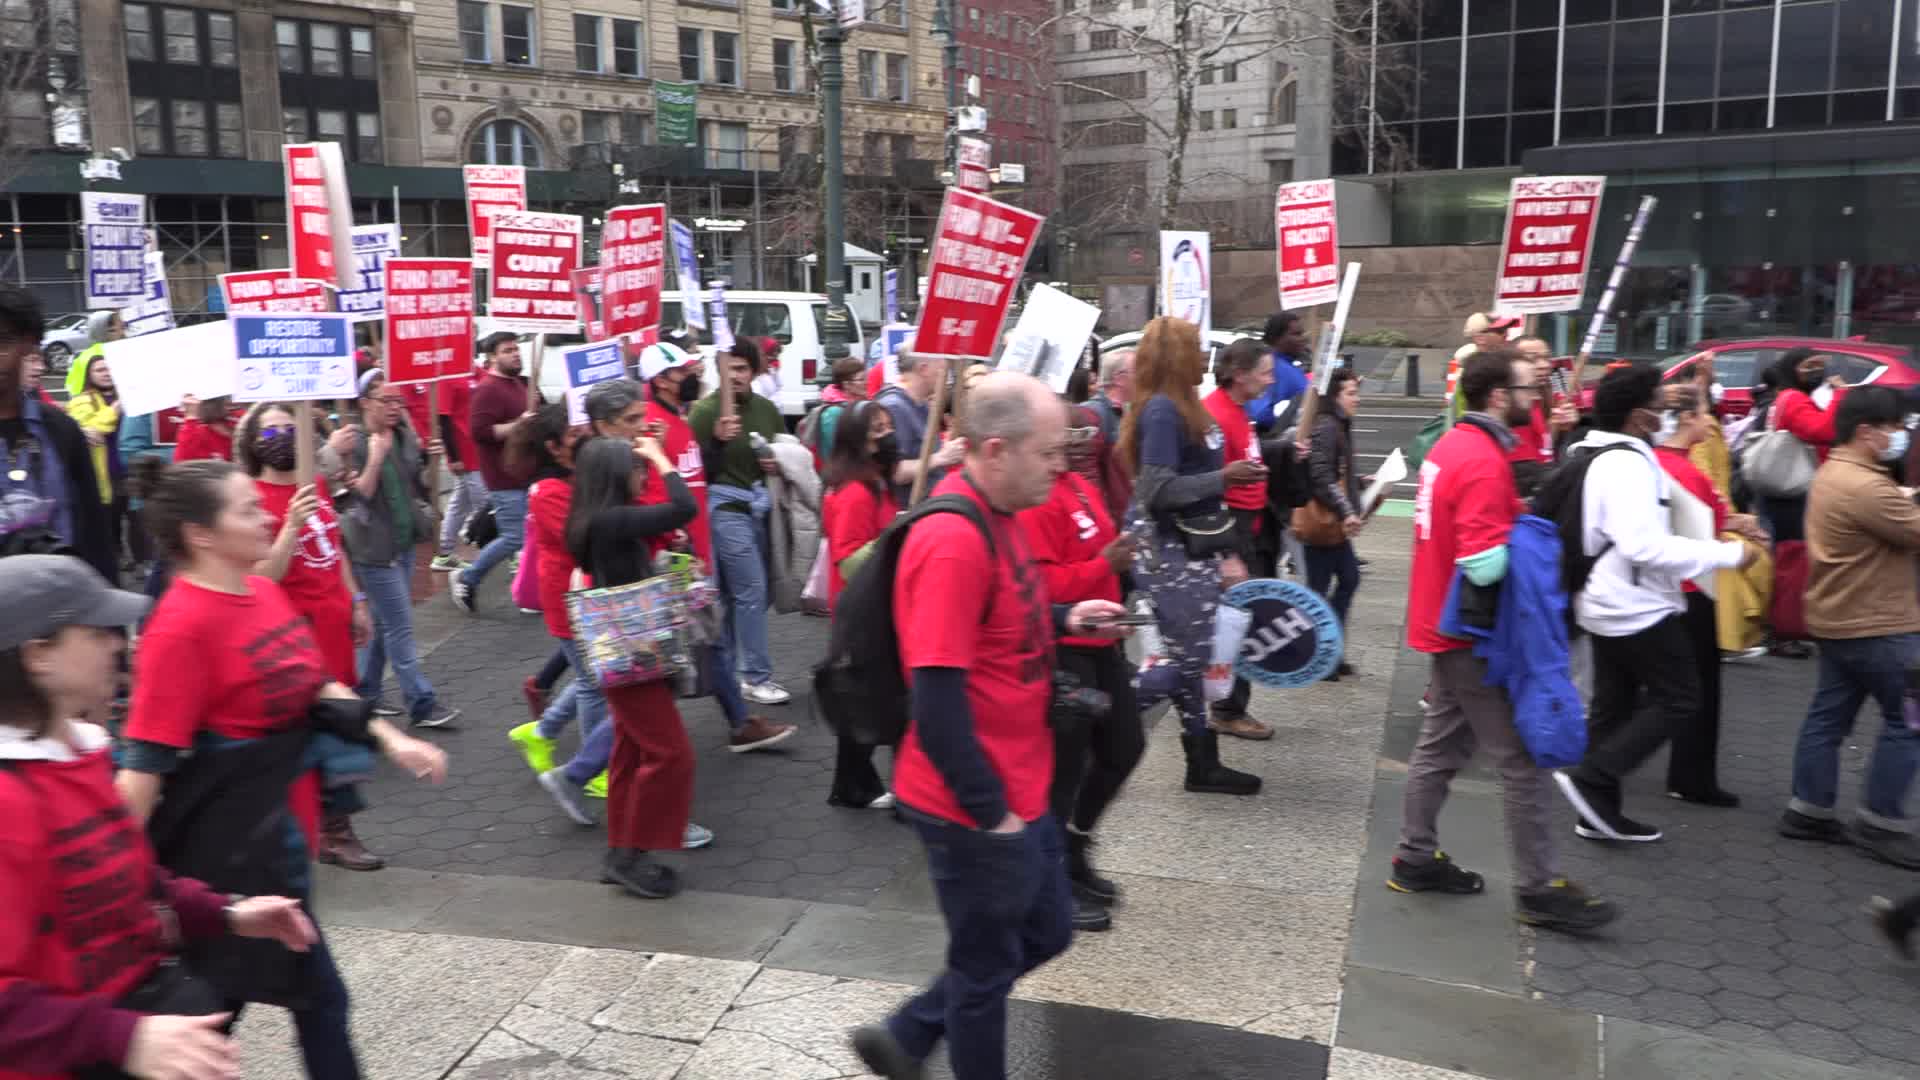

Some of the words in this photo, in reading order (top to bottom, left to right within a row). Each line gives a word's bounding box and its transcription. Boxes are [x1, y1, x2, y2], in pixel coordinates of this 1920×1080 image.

[1279, 183, 1330, 201] PSC-CUNY
[1516, 182, 1601, 196] PSC-CUNY
[1515, 201, 1569, 216] INVEST
[1569, 200, 1592, 215] IN
[494, 214, 577, 231] PSC-CUNY
[496, 231, 551, 247] INVEST
[553, 236, 574, 249] IN
[1284, 226, 1331, 247] FACULTY
[1521, 224, 1577, 246] CUNY
[506, 253, 564, 273] CUNY
[1304, 247, 1318, 265] &
[1508, 252, 1561, 267] INVEST
[1561, 251, 1582, 265] IN
[95, 272, 143, 294] PEOPLE
[391, 269, 429, 289] FUND
[496, 276, 550, 292] INVEST
[551, 278, 572, 293] IN
[1500, 276, 1538, 293] NEW
[1540, 273, 1585, 291] YORK
[229, 280, 273, 299] FUND
[385, 294, 417, 314] THE
[419, 292, 473, 313] PEOPLE'S
[491, 297, 528, 314] NEW
[533, 300, 577, 317] YORK
[264, 320, 323, 337] RESTORE
[396, 316, 468, 340] UNIVERSITY
[248, 338, 336, 355] OPPORTUNITY
